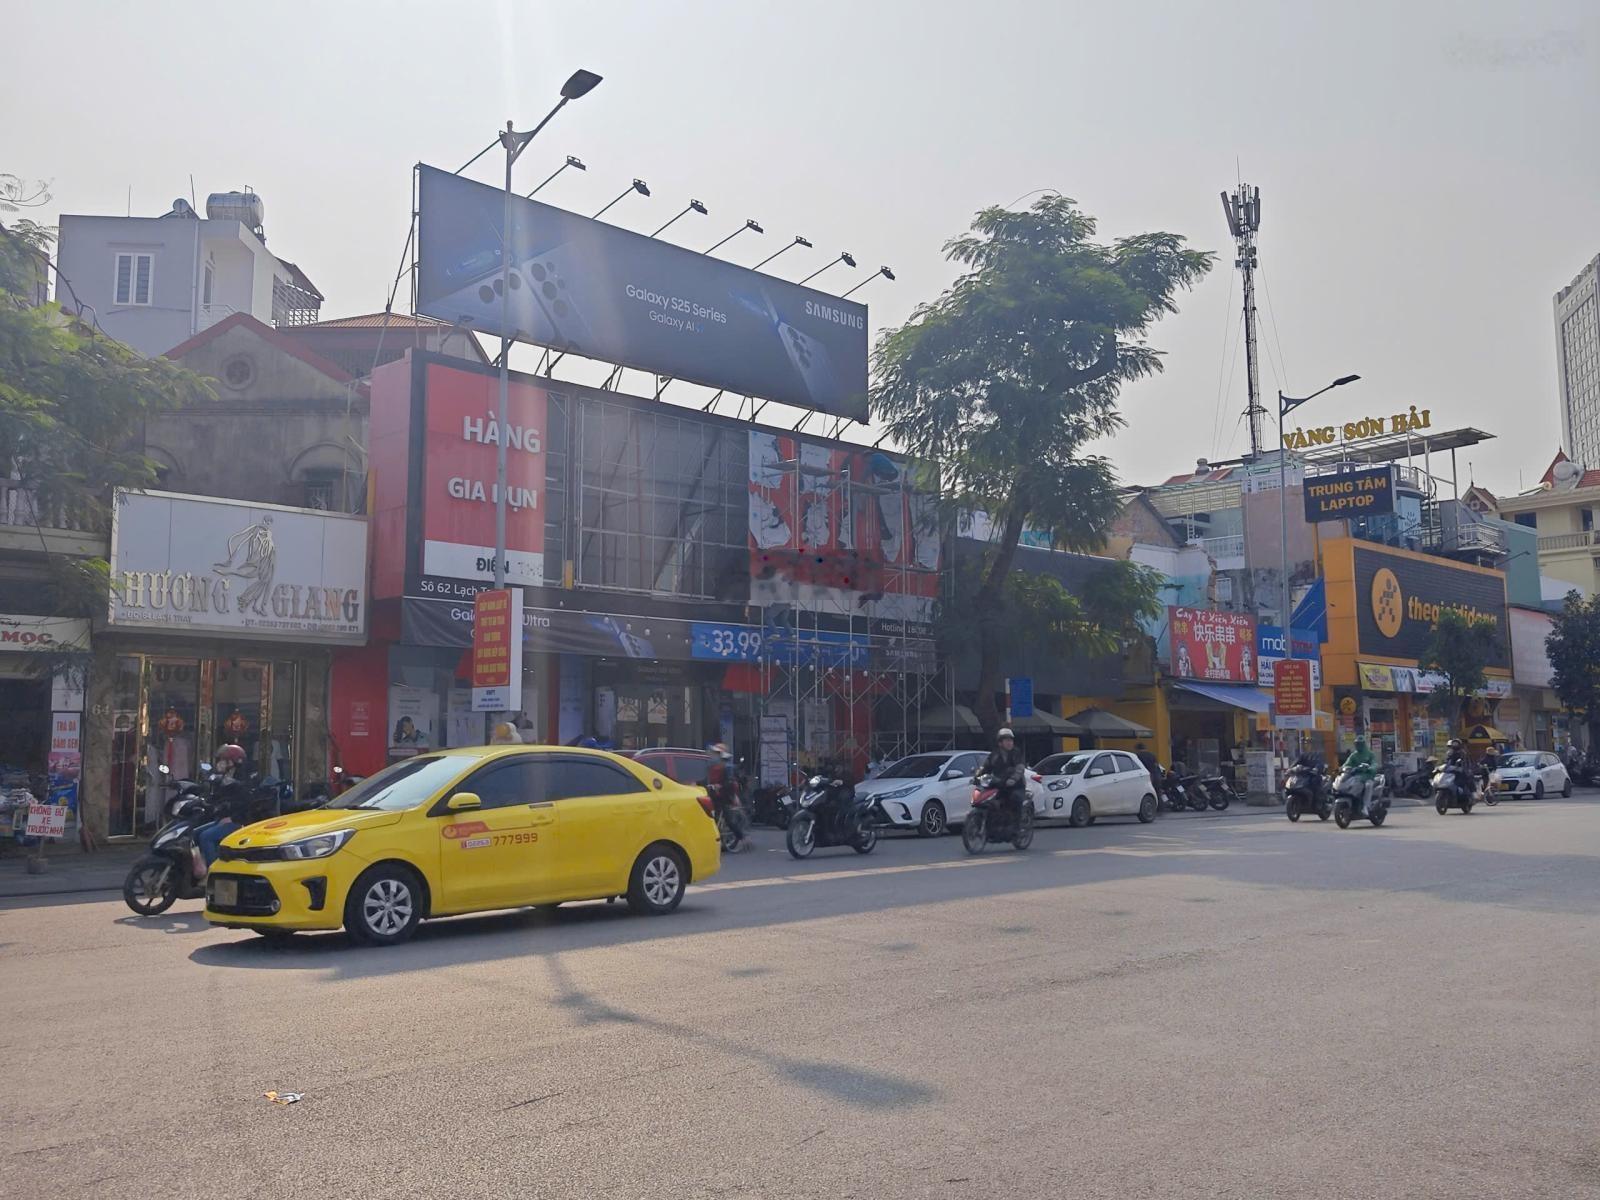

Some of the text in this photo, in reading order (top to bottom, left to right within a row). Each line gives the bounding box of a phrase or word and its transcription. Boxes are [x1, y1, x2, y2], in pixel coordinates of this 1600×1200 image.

[625, 283, 727, 324] Galaxy S25 Series
[649, 310, 695, 332] Galaxy AI
[805, 300, 864, 330] SAMSUNG
[463, 410, 541, 453] HÀNG
[1283, 405, 1431, 449] VÀNG SƠN HẢI
[448, 477, 486, 502] GIA
[1308, 476, 1387, 497] TRUNG TÂM
[1320, 494, 1374, 512] LAPTOP
[122, 569, 231, 614] HƯƠNG
[437, 582, 451, 594] 62
[454, 583, 478, 598] Lạch
[272, 583, 360, 622] GIANG
[1176, 607, 1193, 622] Cay
[1193, 622, 1236, 645] 快乐串串
[91, 704, 110, 716] 64
[41, 816, 52, 825] XE
[493, 832, 538, 847] 777999
